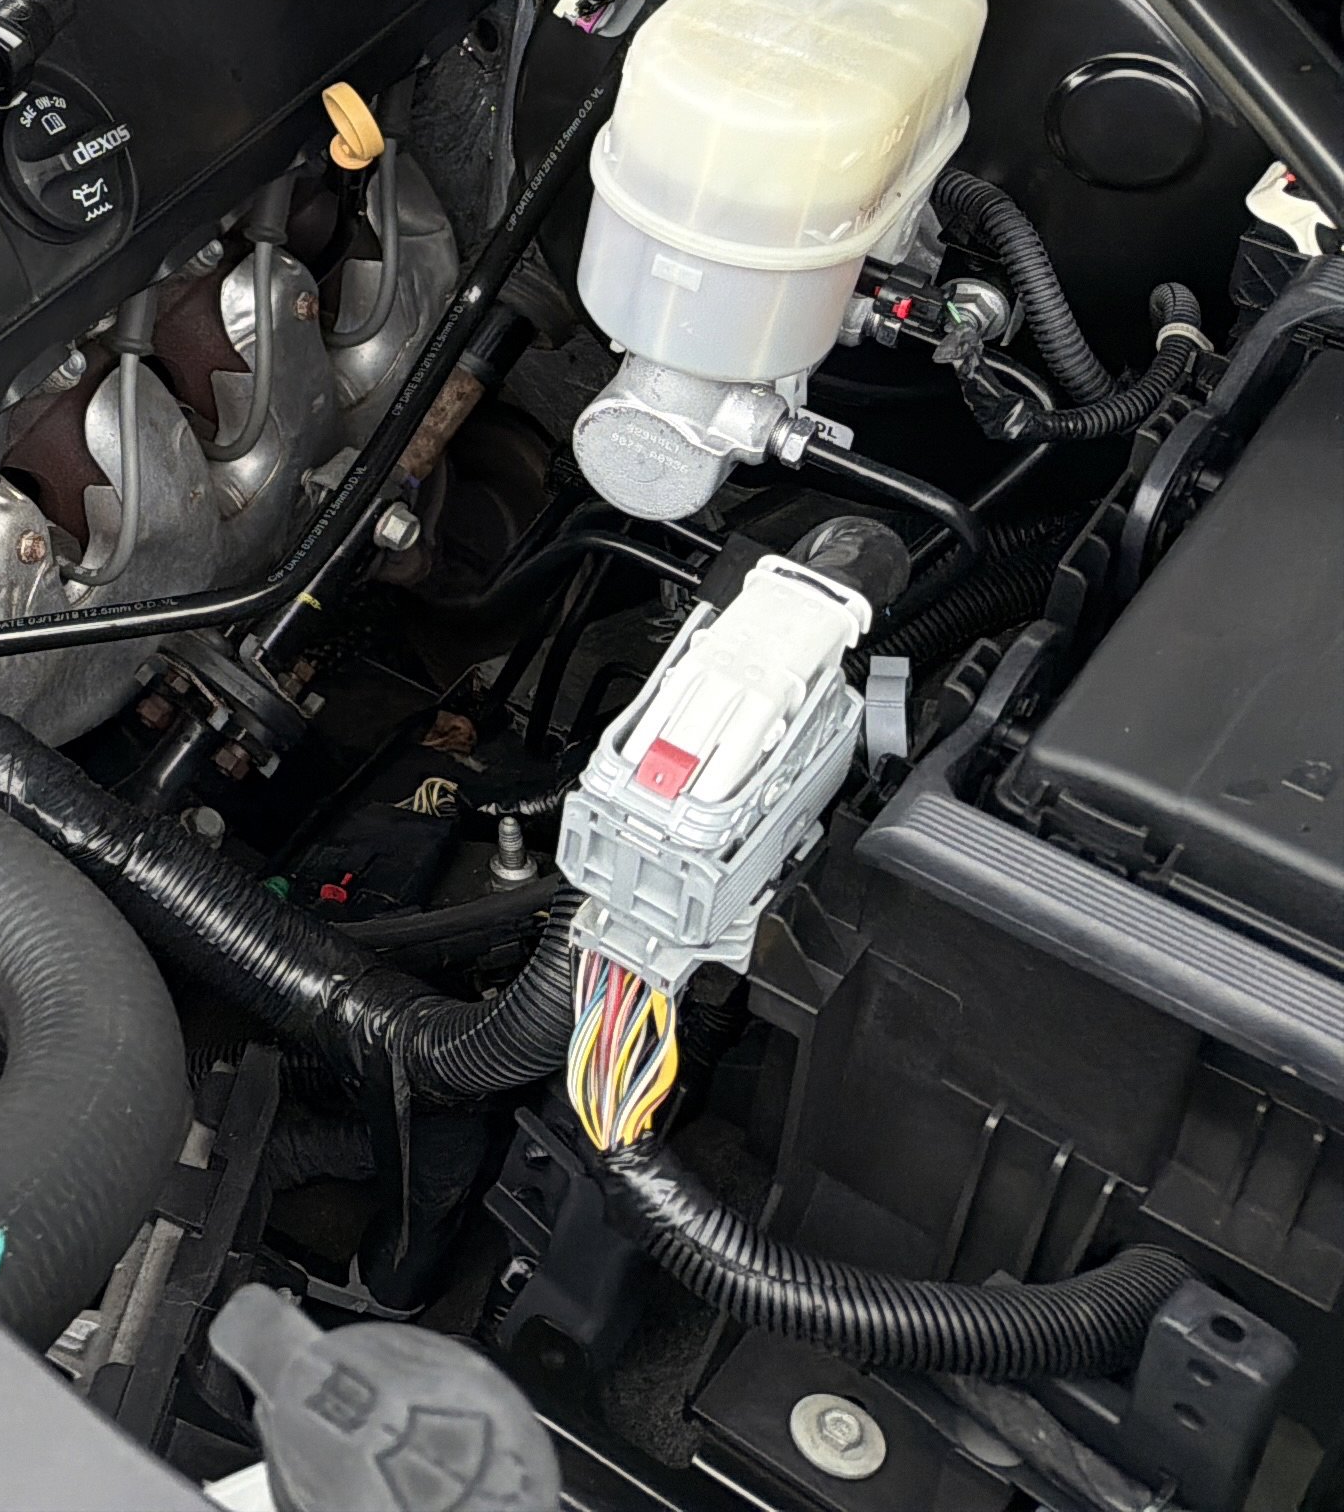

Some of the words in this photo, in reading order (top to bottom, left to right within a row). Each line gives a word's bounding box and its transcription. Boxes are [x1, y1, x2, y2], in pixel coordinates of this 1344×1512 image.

[18, 105, 37, 128] SAE
[35, 95, 67, 110] 0W-20
[72, 123, 131, 166] dexos
[512, 187, 536, 217] DATE
[527, 150, 560, 192] 03/12/19
[552, 115, 583, 154] 12.5mm
[81, 602, 132, 618] 12.5mm
